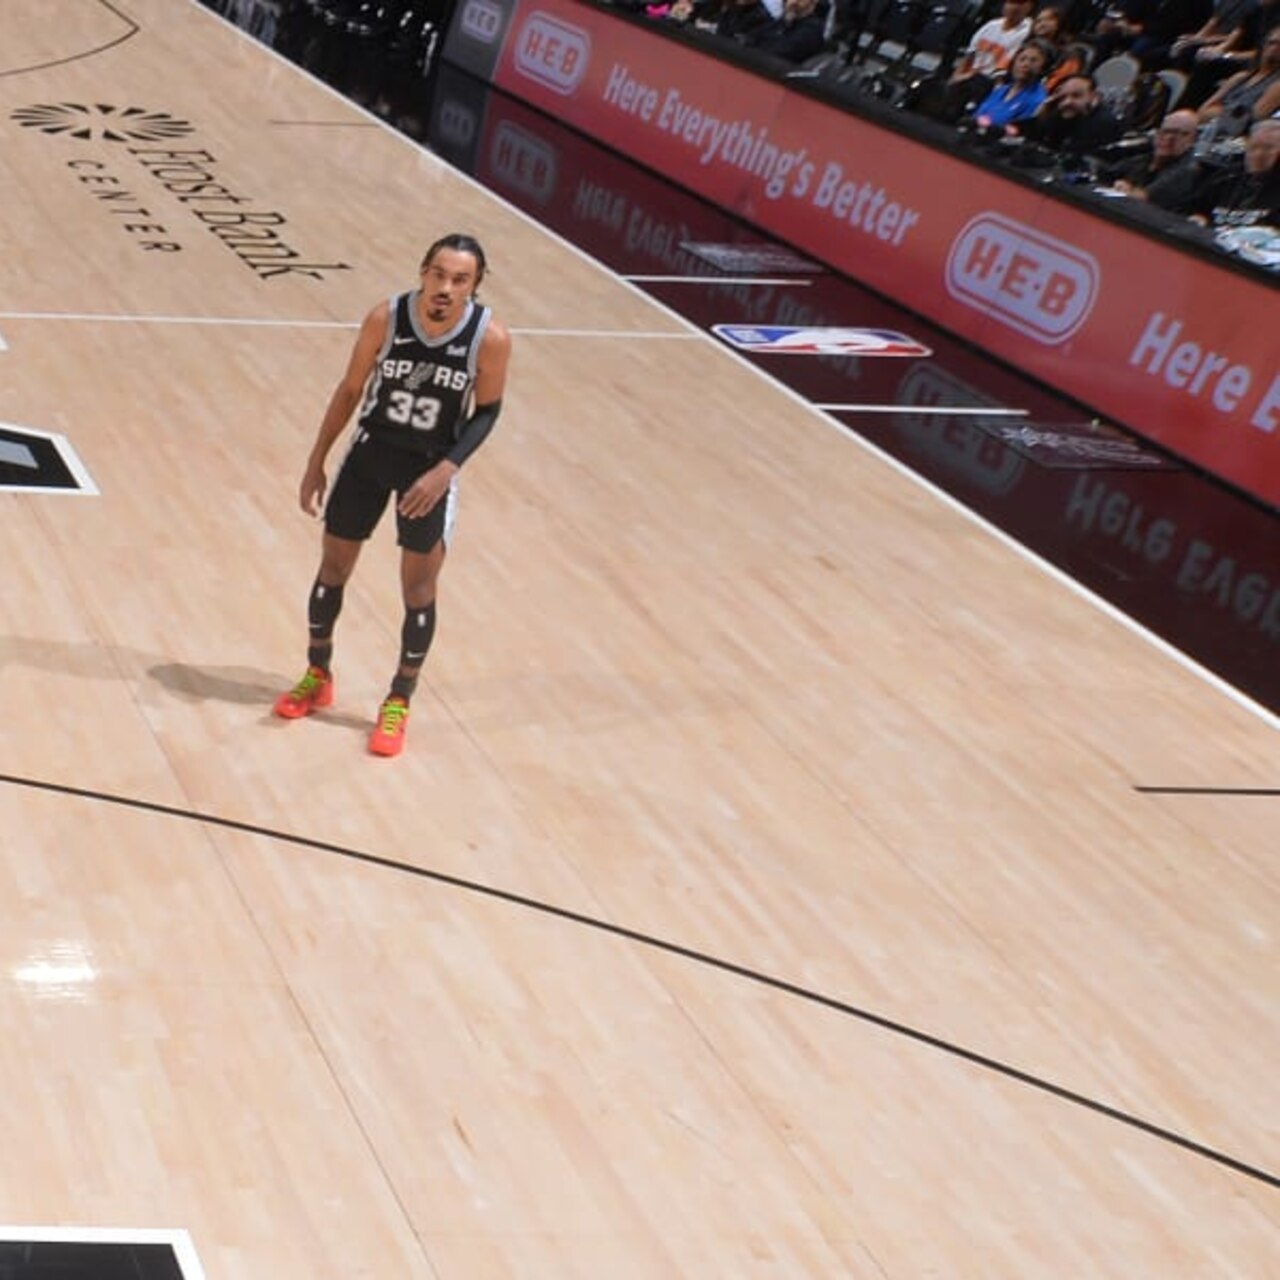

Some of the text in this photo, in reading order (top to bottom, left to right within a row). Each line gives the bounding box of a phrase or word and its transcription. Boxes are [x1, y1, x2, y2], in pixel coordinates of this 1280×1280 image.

[66, 158, 182, 253] CENTER
[603, 64, 921, 248] Here Everything's Better
[126, 146, 353, 280] Frost Bank
[386, 390, 441, 430] 33
[1129, 311, 1252, 414] Here
